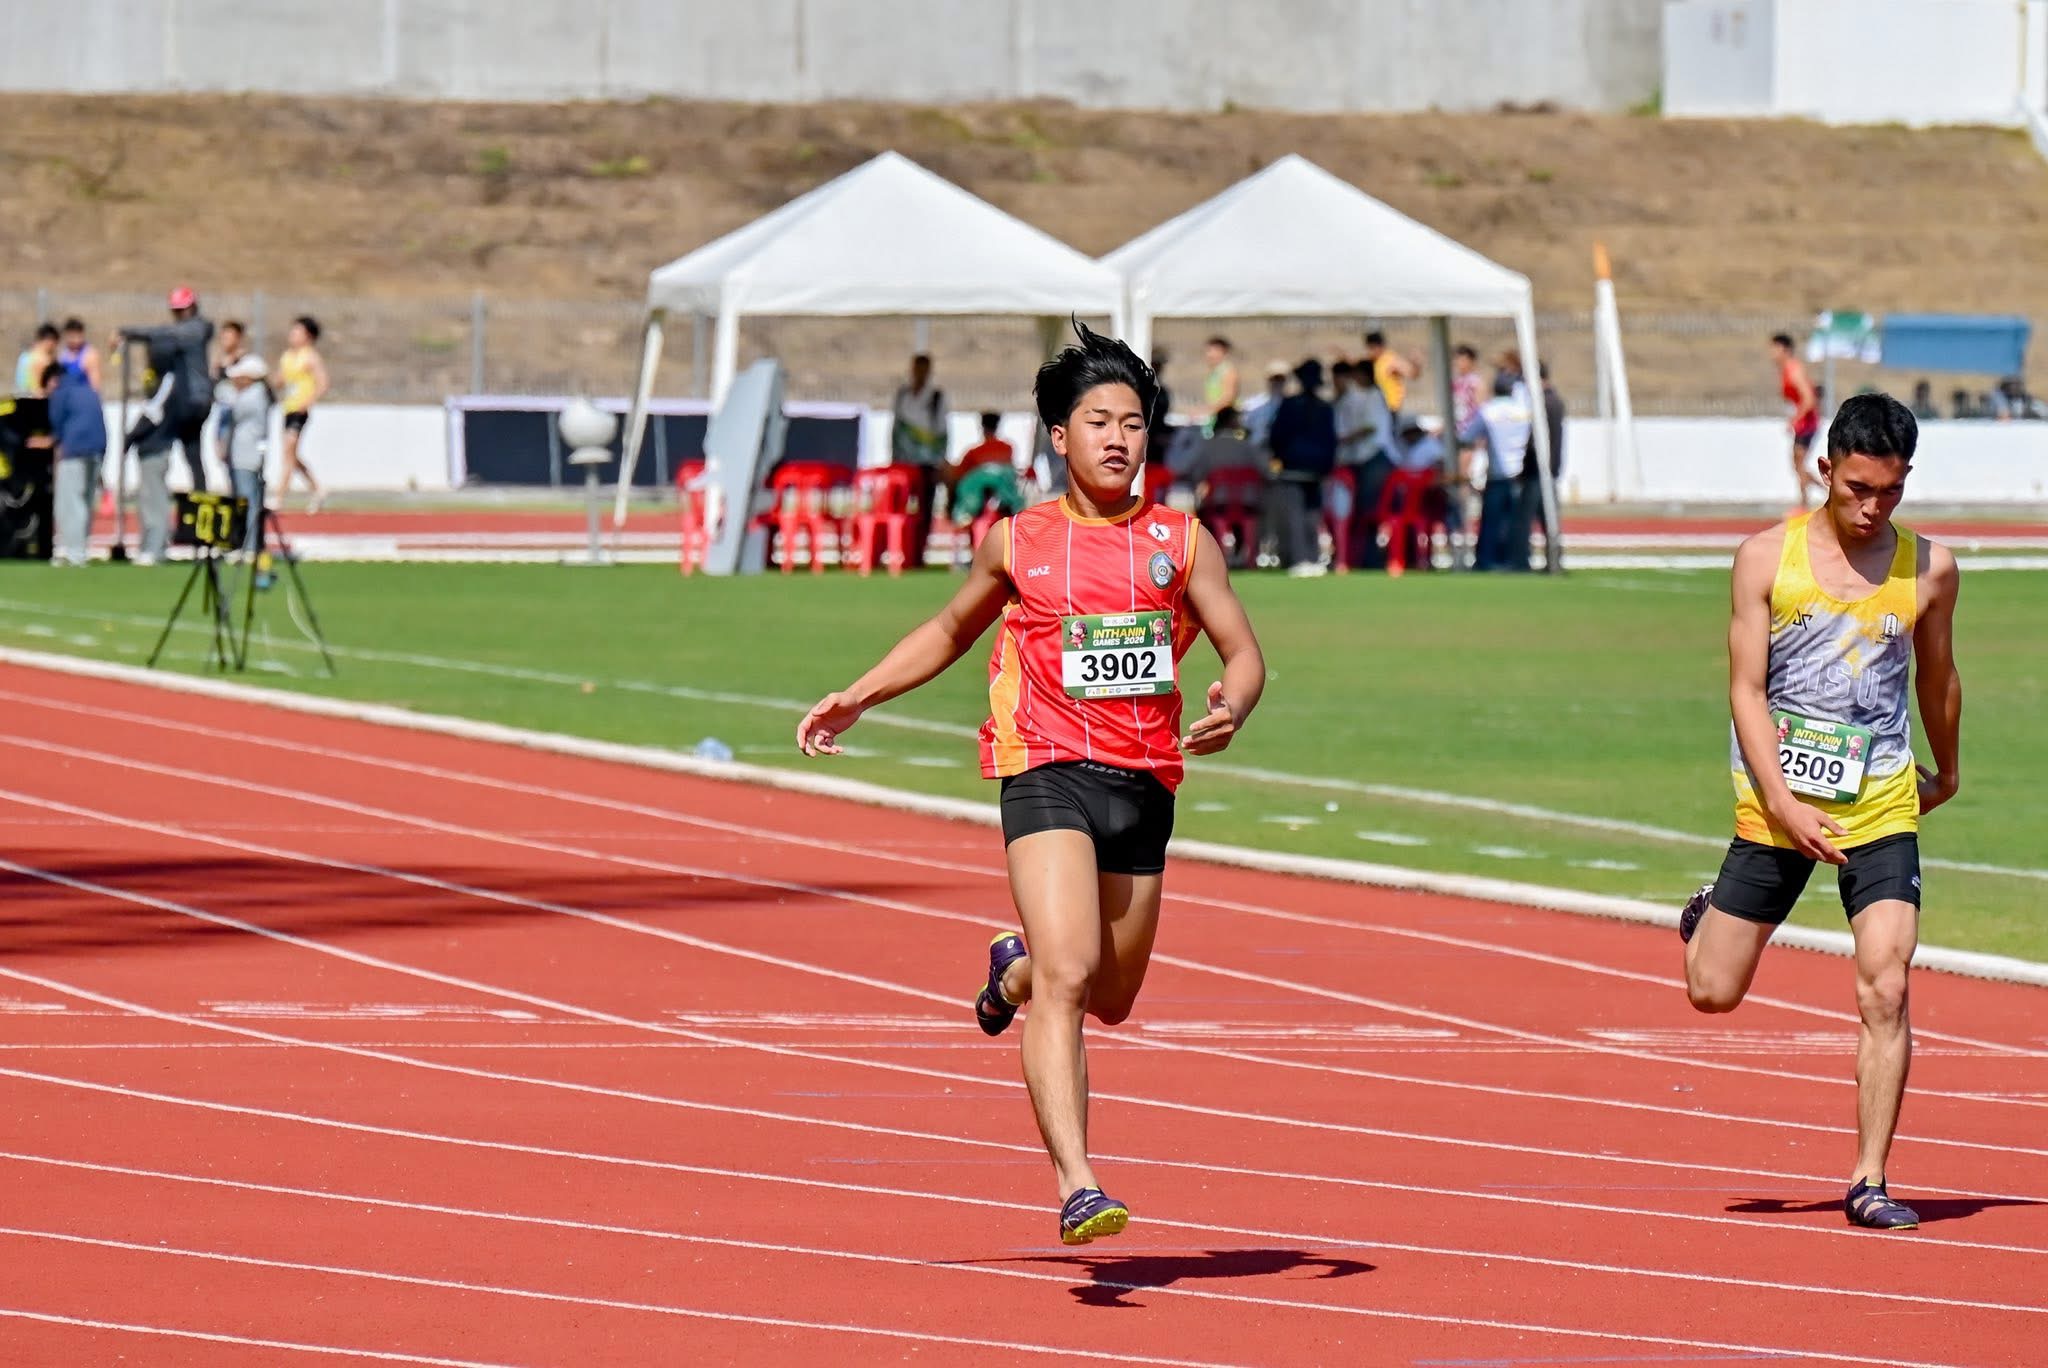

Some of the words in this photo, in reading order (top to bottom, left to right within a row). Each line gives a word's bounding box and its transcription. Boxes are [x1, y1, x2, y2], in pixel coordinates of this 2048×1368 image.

[1027, 565, 1051, 578] DIAZ
[1092, 627, 1146, 639] INTHANIN
[1092, 638, 1120, 647] GAMES
[1123, 636, 1145, 645] 2026
[1080, 650, 1157, 682] 3902
[1783, 656, 1881, 710] MSU
[1791, 736, 1816, 748] GAMES
[1793, 728, 1843, 746] INTHANIN
[1779, 749, 1845, 785] 2509
